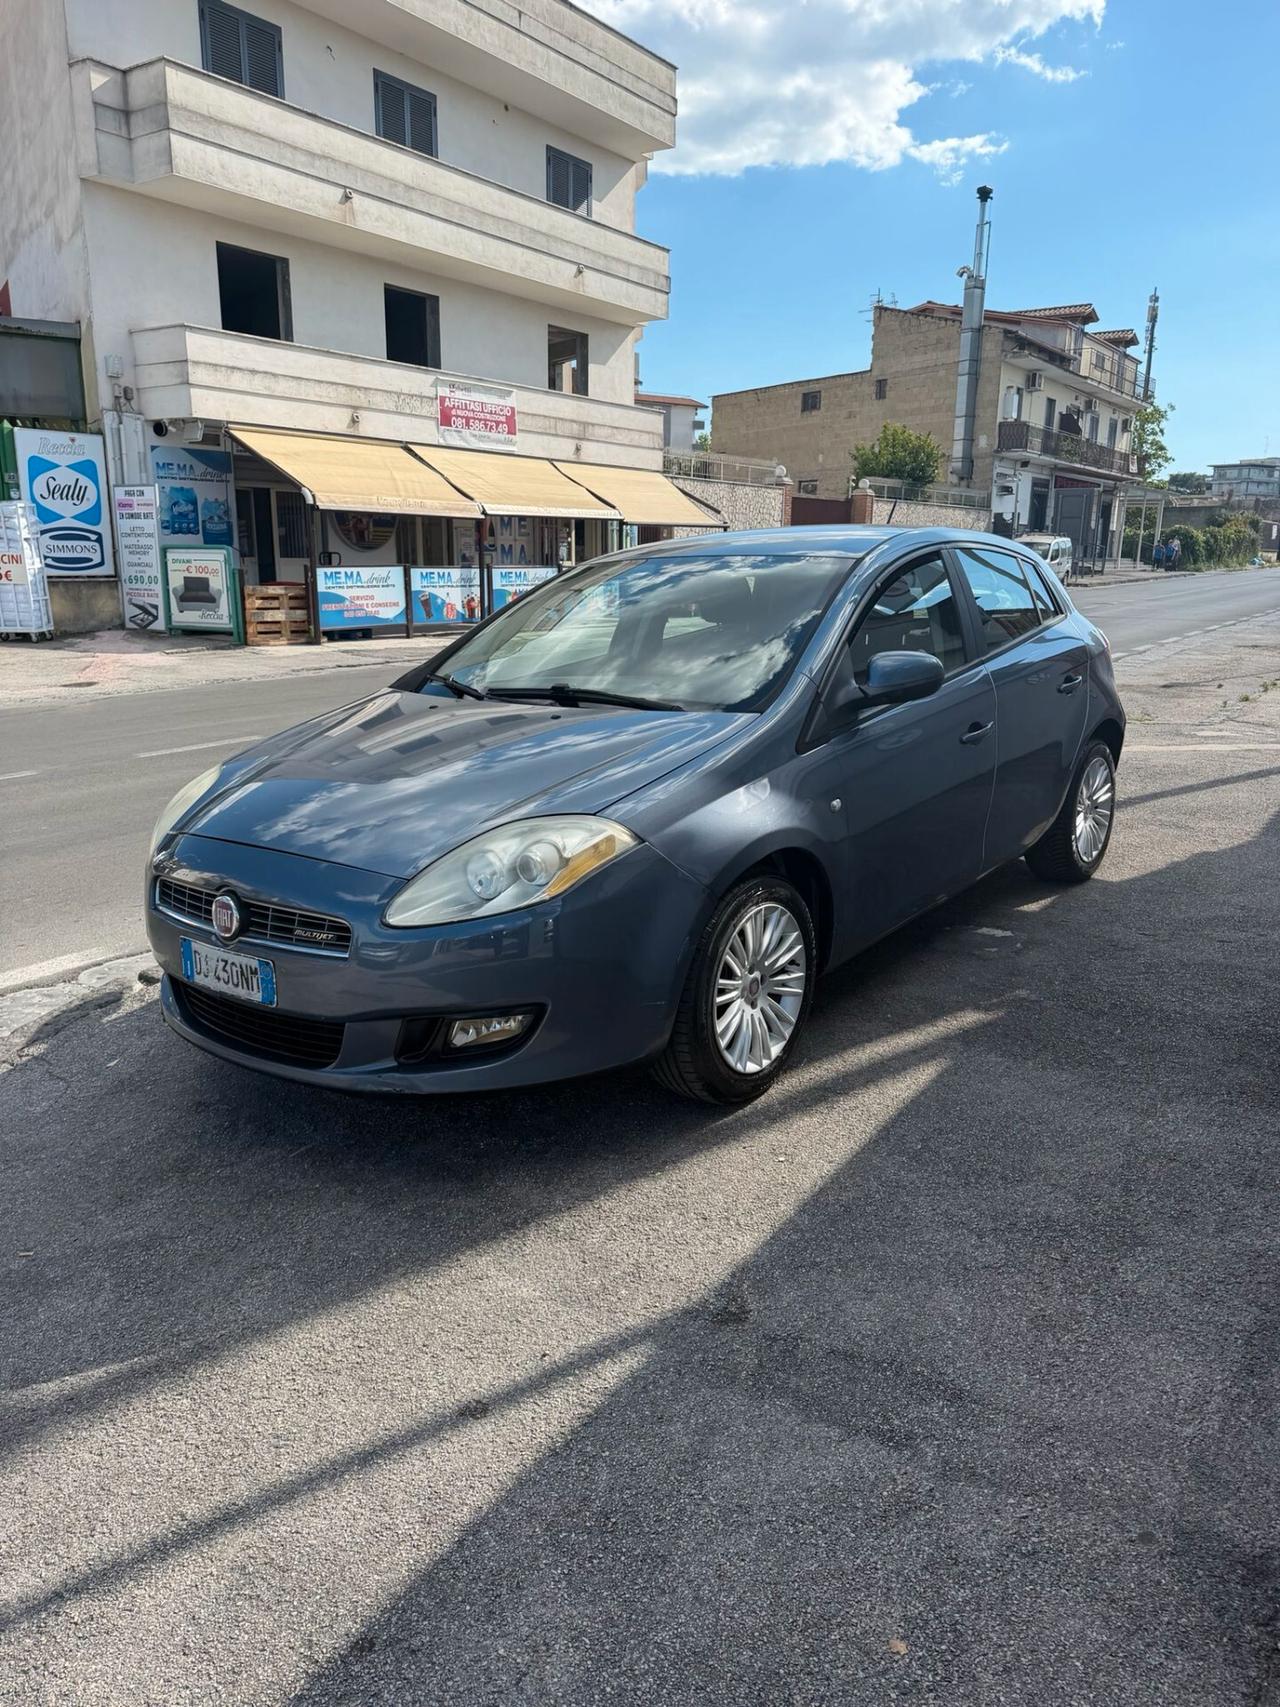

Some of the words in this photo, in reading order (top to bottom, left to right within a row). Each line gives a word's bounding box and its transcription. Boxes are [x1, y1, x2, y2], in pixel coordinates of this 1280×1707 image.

[445, 398, 482, 413] AFFITTASI
[483, 403, 511, 416] UFFICIO
[457, 409, 474, 417] NUOVA
[37, 437, 86, 456] Reccia
[40, 476, 88, 506] Sealy
[46, 544, 97, 554] SIMMONS
[1, 554, 22, 565] CINI
[324, 571, 362, 585] ME.MA
[217, 907, 232, 928] FIAT
[294, 929, 334, 940] MULTIJET
